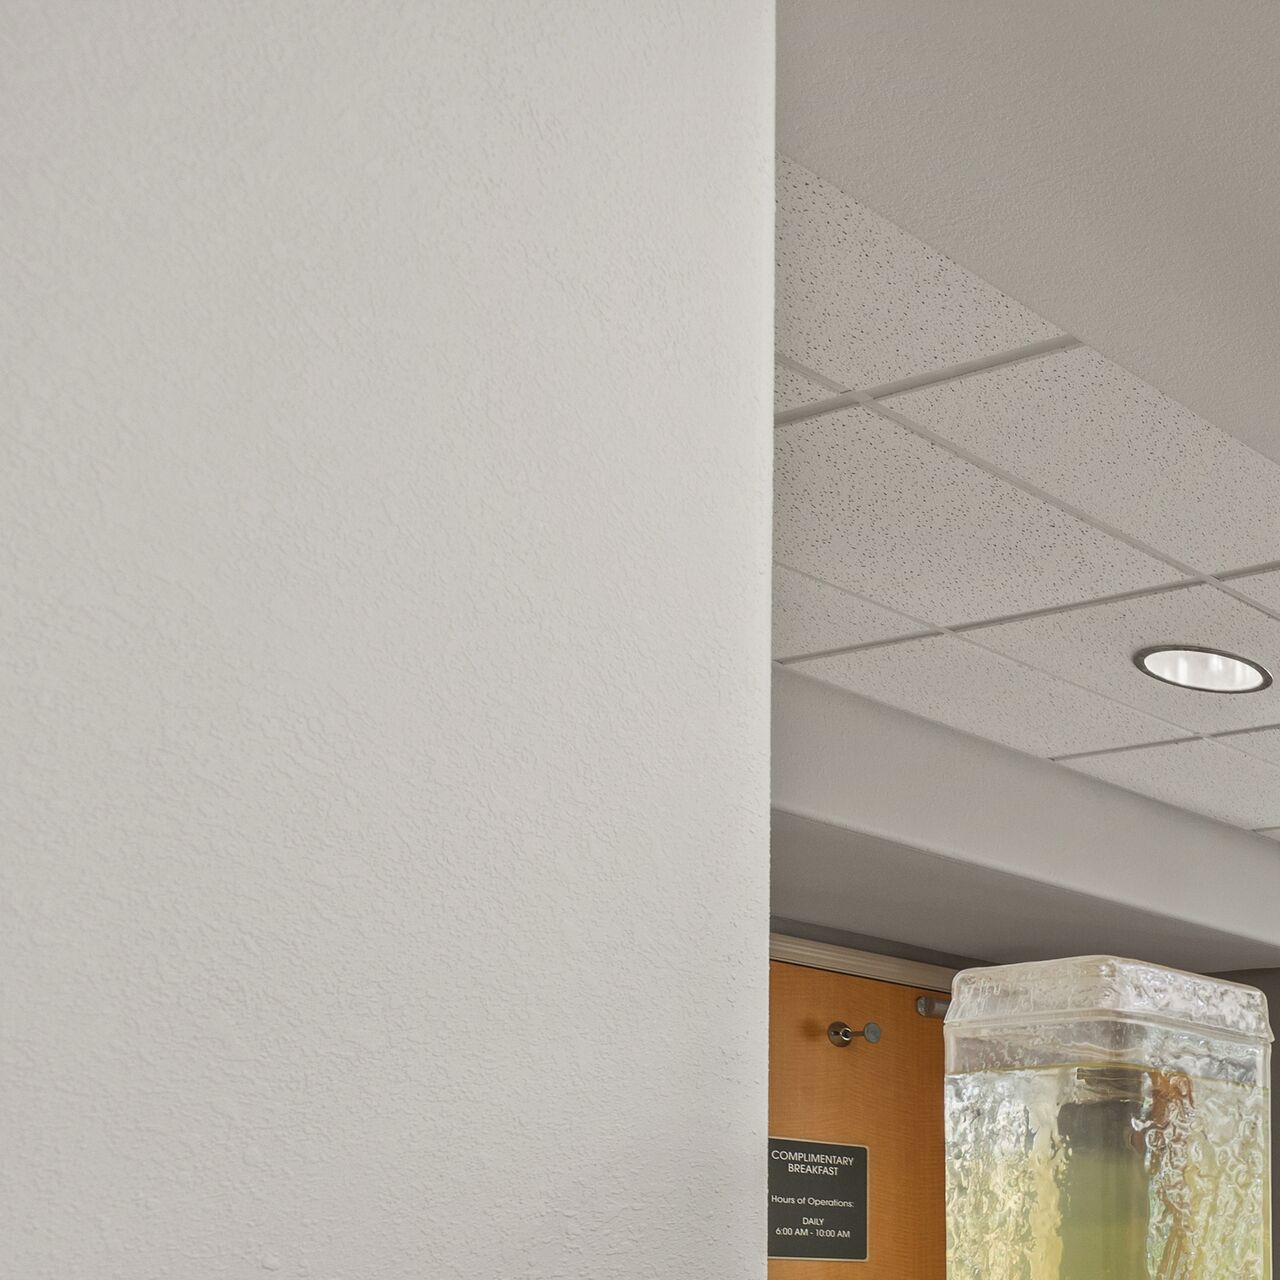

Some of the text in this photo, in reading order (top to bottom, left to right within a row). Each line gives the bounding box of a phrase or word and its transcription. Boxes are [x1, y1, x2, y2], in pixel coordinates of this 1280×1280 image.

[771, 1150, 854, 1166] COMPLIMENTARY
[788, 1163, 838, 1176] BREAKFAST
[771, 1195, 854, 1208] Hours of Operations:
[802, 1216, 824, 1226] DAILY
[775, 1227, 793, 1236] 6:00
[794, 1228, 808, 1236] AM
[815, 1229, 836, 1238] 10:00
[837, 1230, 851, 1238] AM
